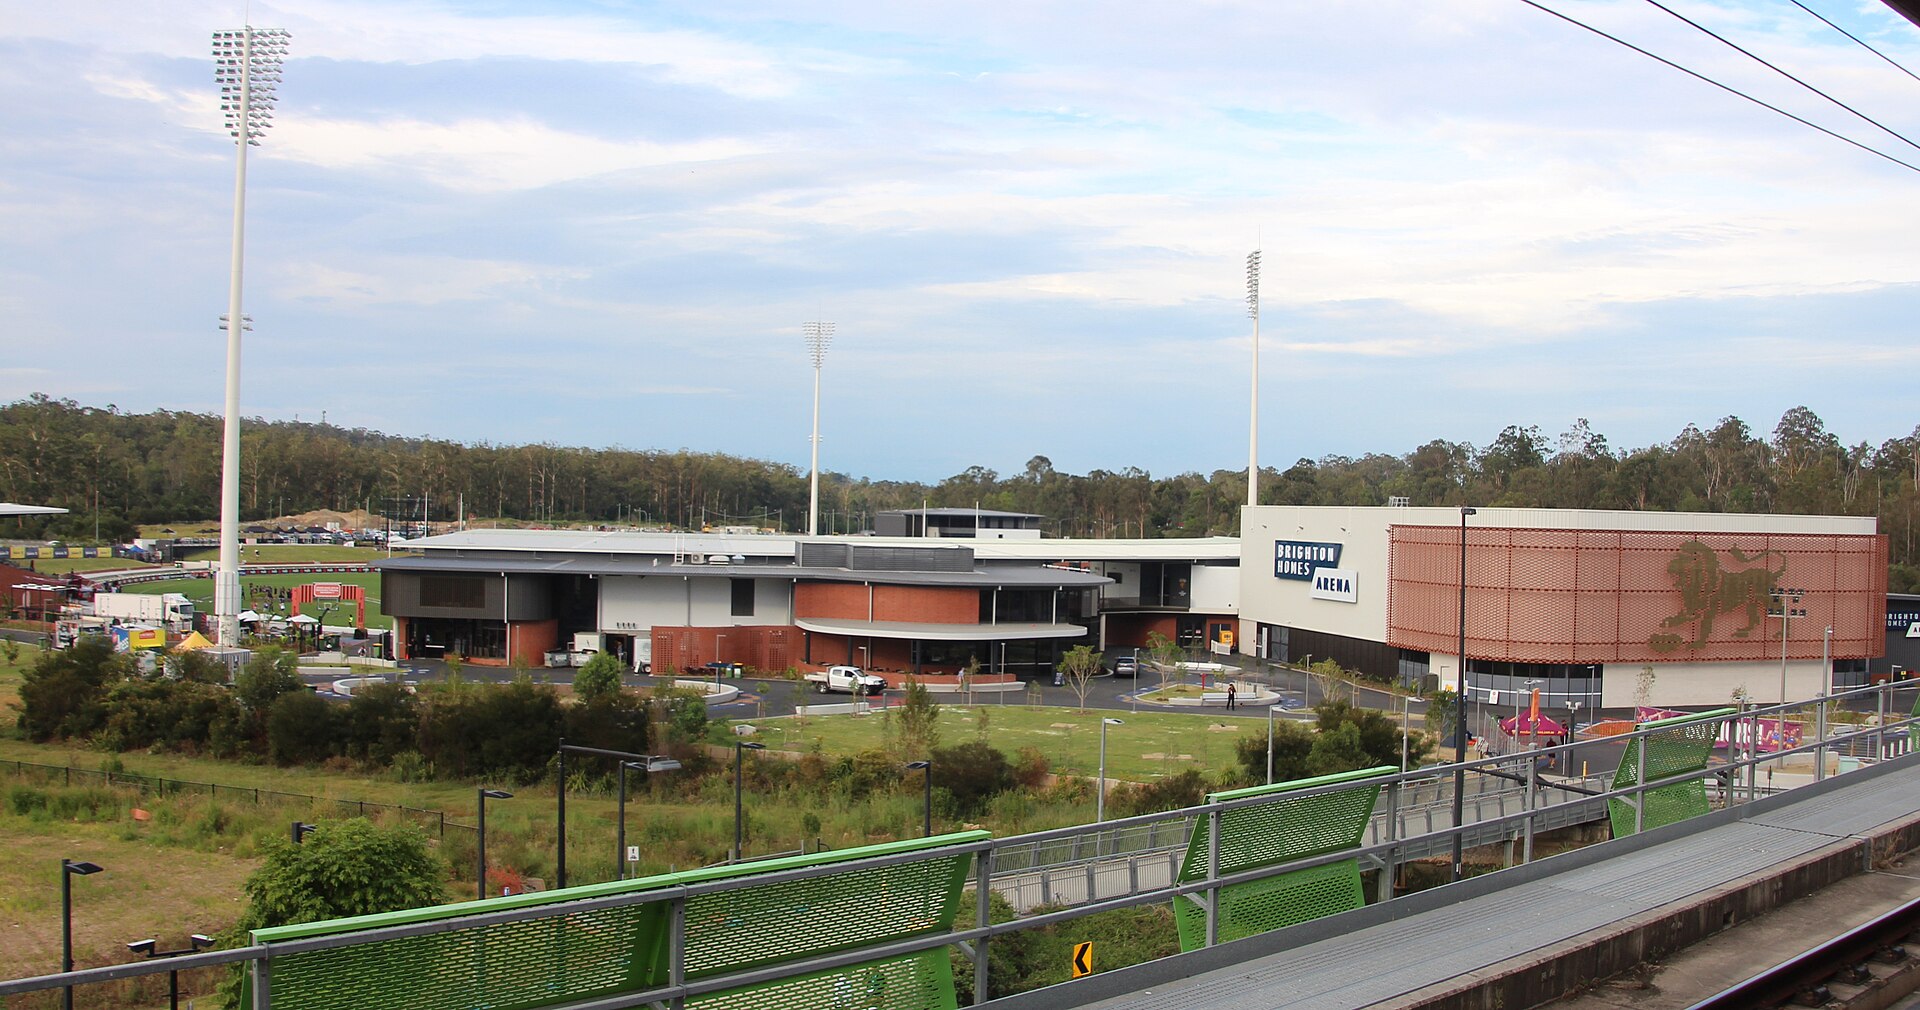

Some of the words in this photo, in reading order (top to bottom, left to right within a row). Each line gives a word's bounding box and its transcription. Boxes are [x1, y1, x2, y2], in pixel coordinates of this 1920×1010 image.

[1277, 544, 1335, 562] BRIGHTON
[1277, 560, 1310, 576] HOMES
[1316, 576, 1351, 593] ARENA
